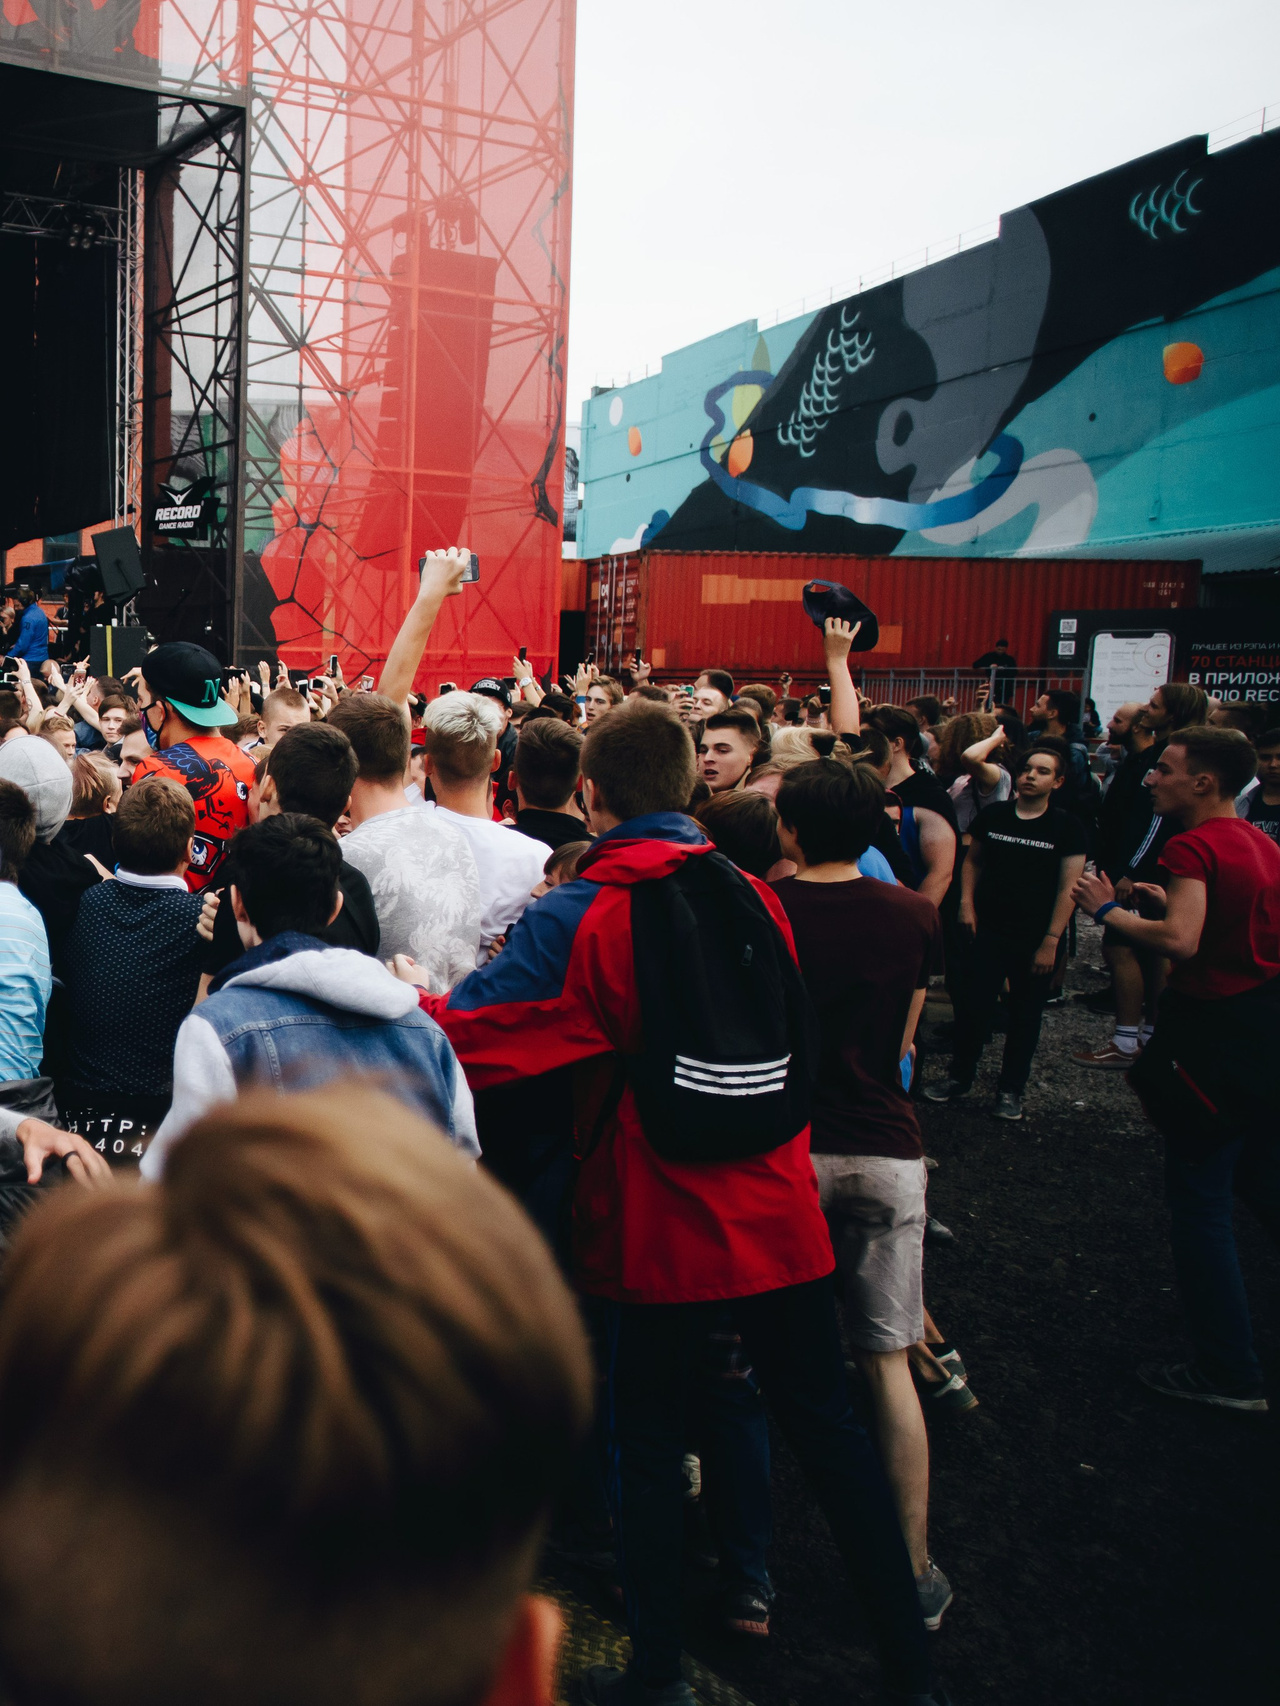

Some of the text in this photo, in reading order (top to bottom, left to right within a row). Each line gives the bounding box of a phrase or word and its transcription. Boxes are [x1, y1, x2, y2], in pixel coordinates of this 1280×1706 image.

[154, 504, 202, 521] RECORD
[158, 521, 194, 530] DANCE RADIO
[1191, 643, 1228, 651] ЛУЧШЕЕ
[1191, 655, 1211, 668] 70
[1188, 672, 1201, 685] В
[201, 677, 221, 703] N
[94, 1137, 143, 1157] 404
